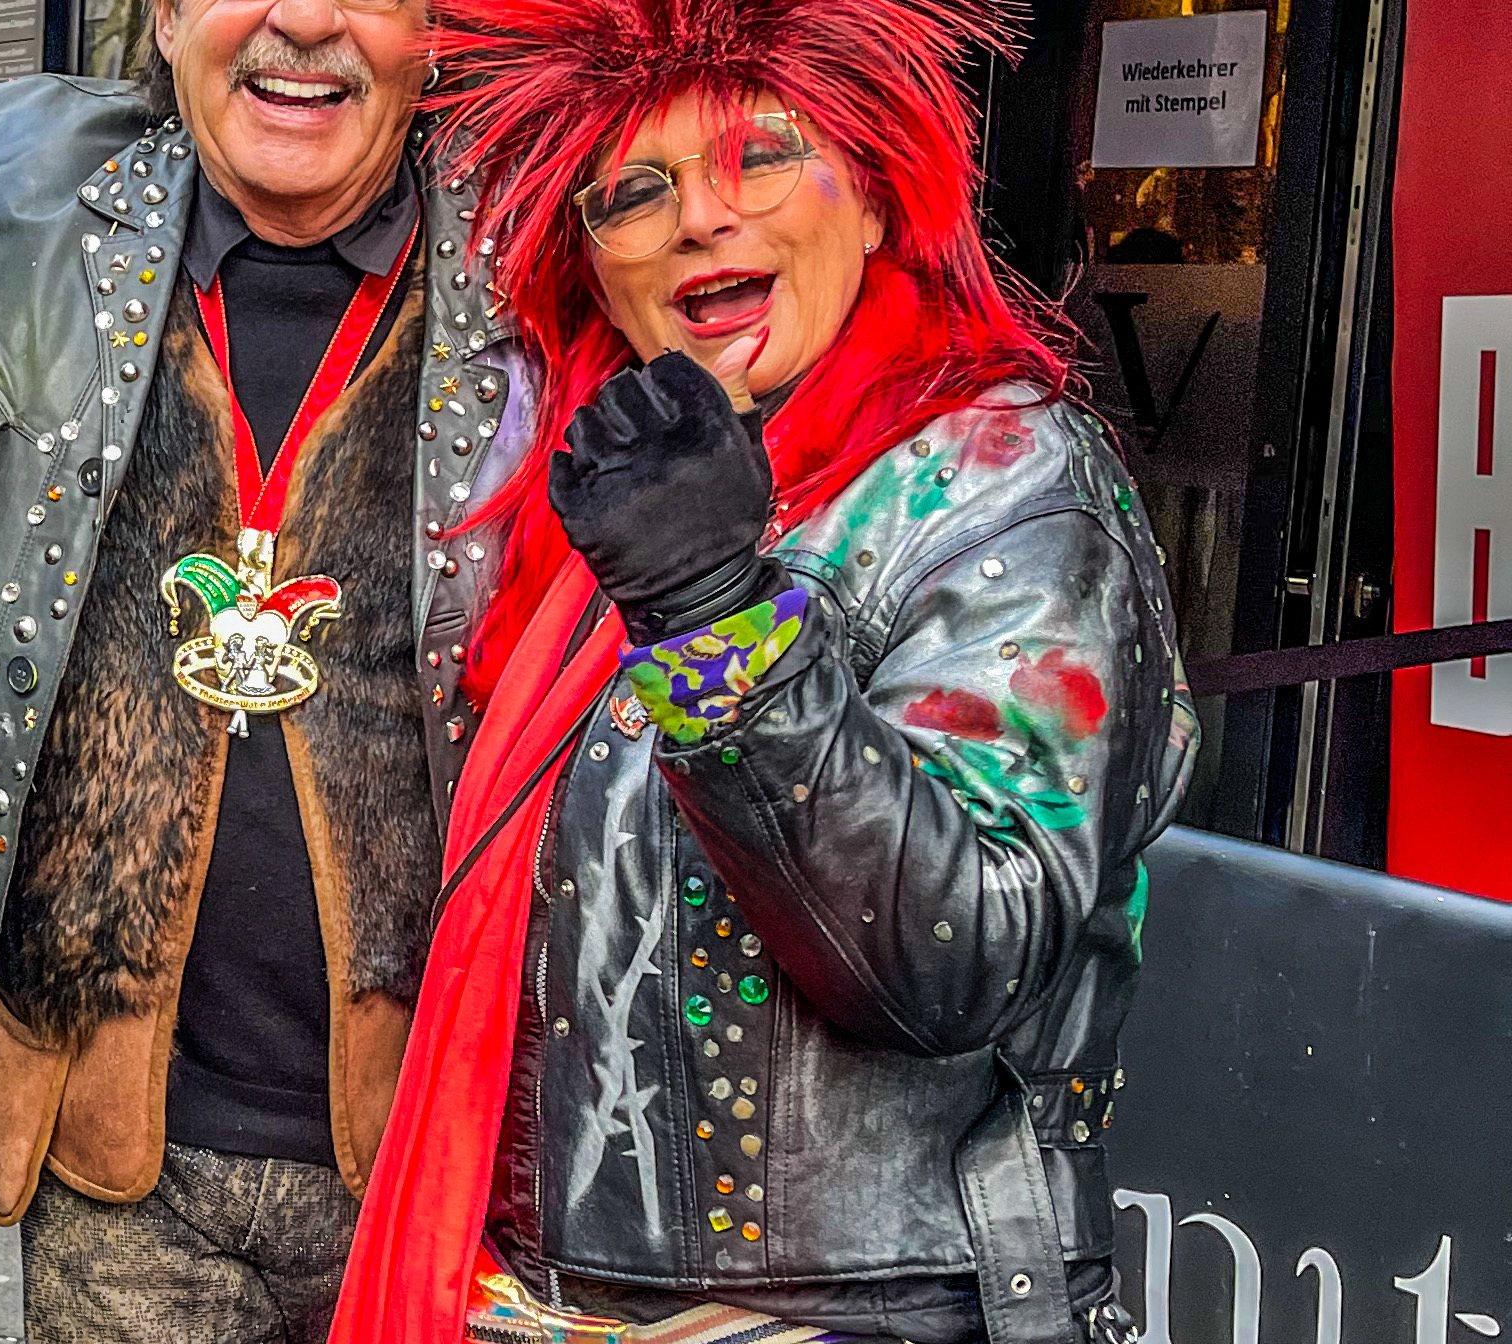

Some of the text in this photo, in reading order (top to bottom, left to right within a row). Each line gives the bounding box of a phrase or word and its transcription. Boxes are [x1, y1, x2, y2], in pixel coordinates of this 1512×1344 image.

[1122, 58, 1238, 82] Wiederkehrer
[1125, 90, 1227, 116] mit Stempel
